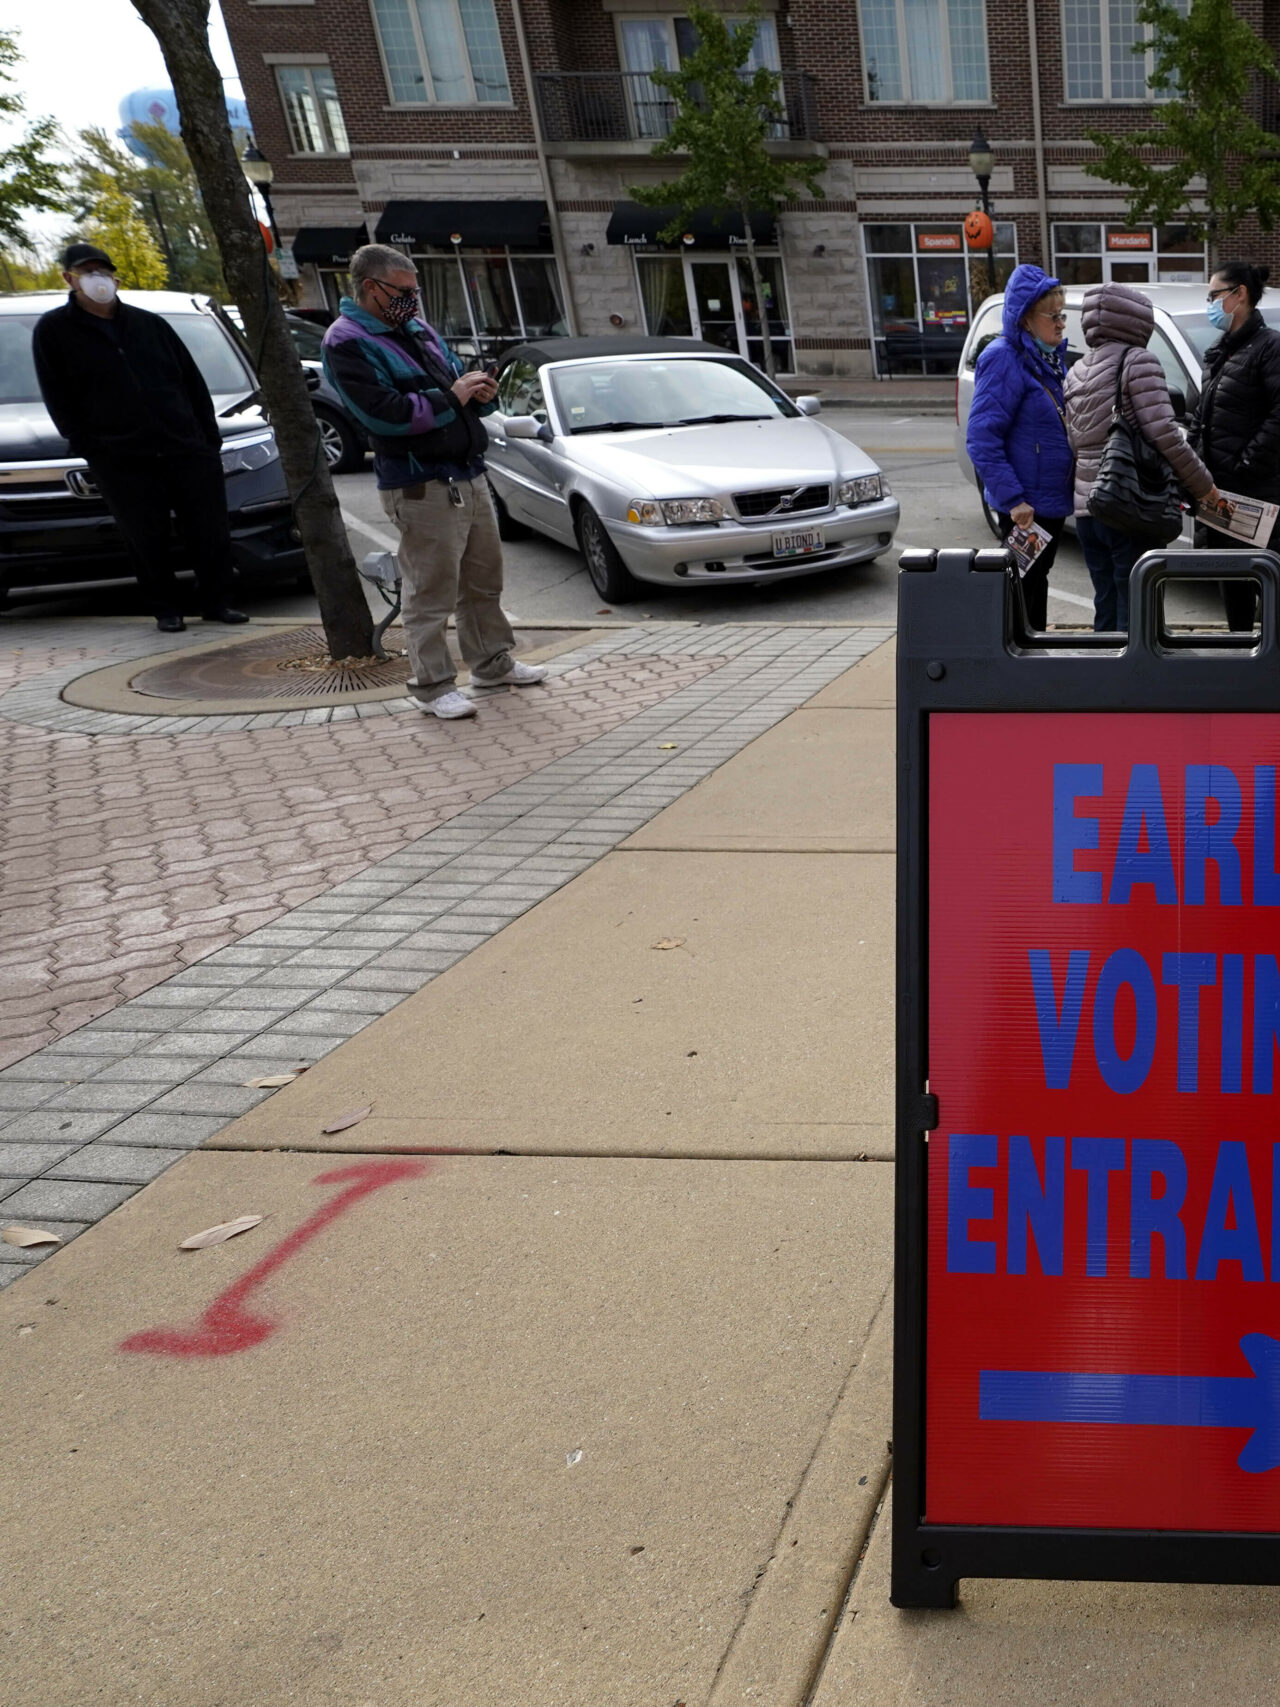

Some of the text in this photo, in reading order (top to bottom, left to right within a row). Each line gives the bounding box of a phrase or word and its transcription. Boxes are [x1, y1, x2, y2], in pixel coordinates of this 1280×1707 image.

[390, 232, 416, 244] Gelato
[624, 233, 648, 244] Lunch
[728, 234, 756, 245] Dinnr
[924, 237, 956, 246] Spanish
[1111, 236, 1149, 246] Mandarin
[775, 538, 782, 551] U
[816, 532, 821, 544] 1
